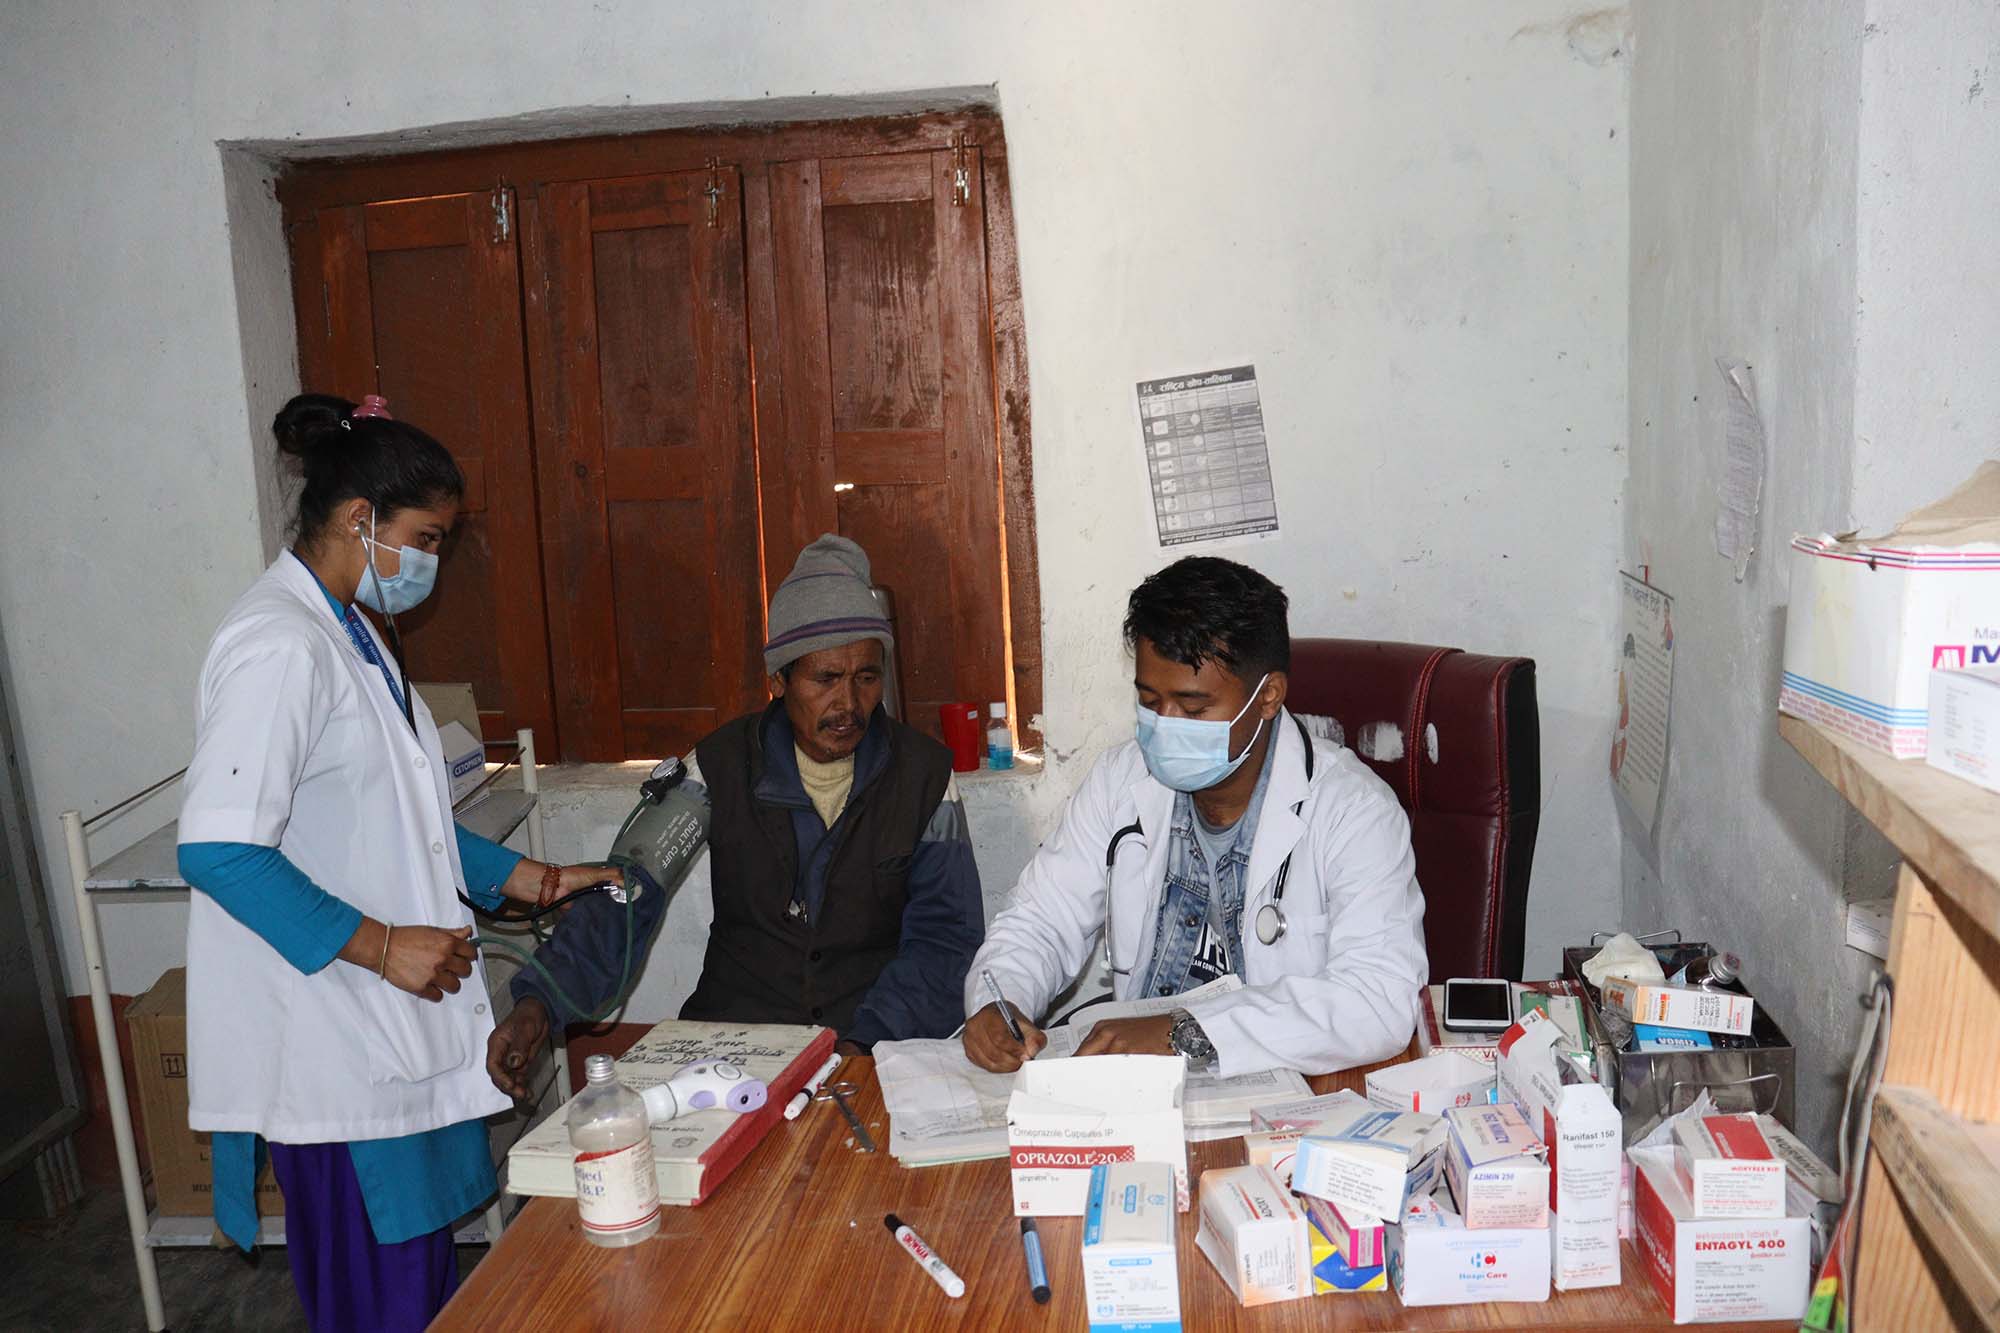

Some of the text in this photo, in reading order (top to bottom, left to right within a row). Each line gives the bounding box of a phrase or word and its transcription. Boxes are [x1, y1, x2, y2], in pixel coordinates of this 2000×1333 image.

[678, 816, 699, 845] ADULT
[661, 845, 679, 869] CUFF
[1657, 1037, 1697, 1048] VOMIZ
[1013, 1128, 1063, 1141] Omeprazole
[1105, 1128, 1114, 1137] IP
[1562, 1129, 1615, 1142] Ranifast 150
[1473, 1172, 1515, 1181] AZIMIN 250
[1695, 1239, 1785, 1251] ENTAGYL 400
